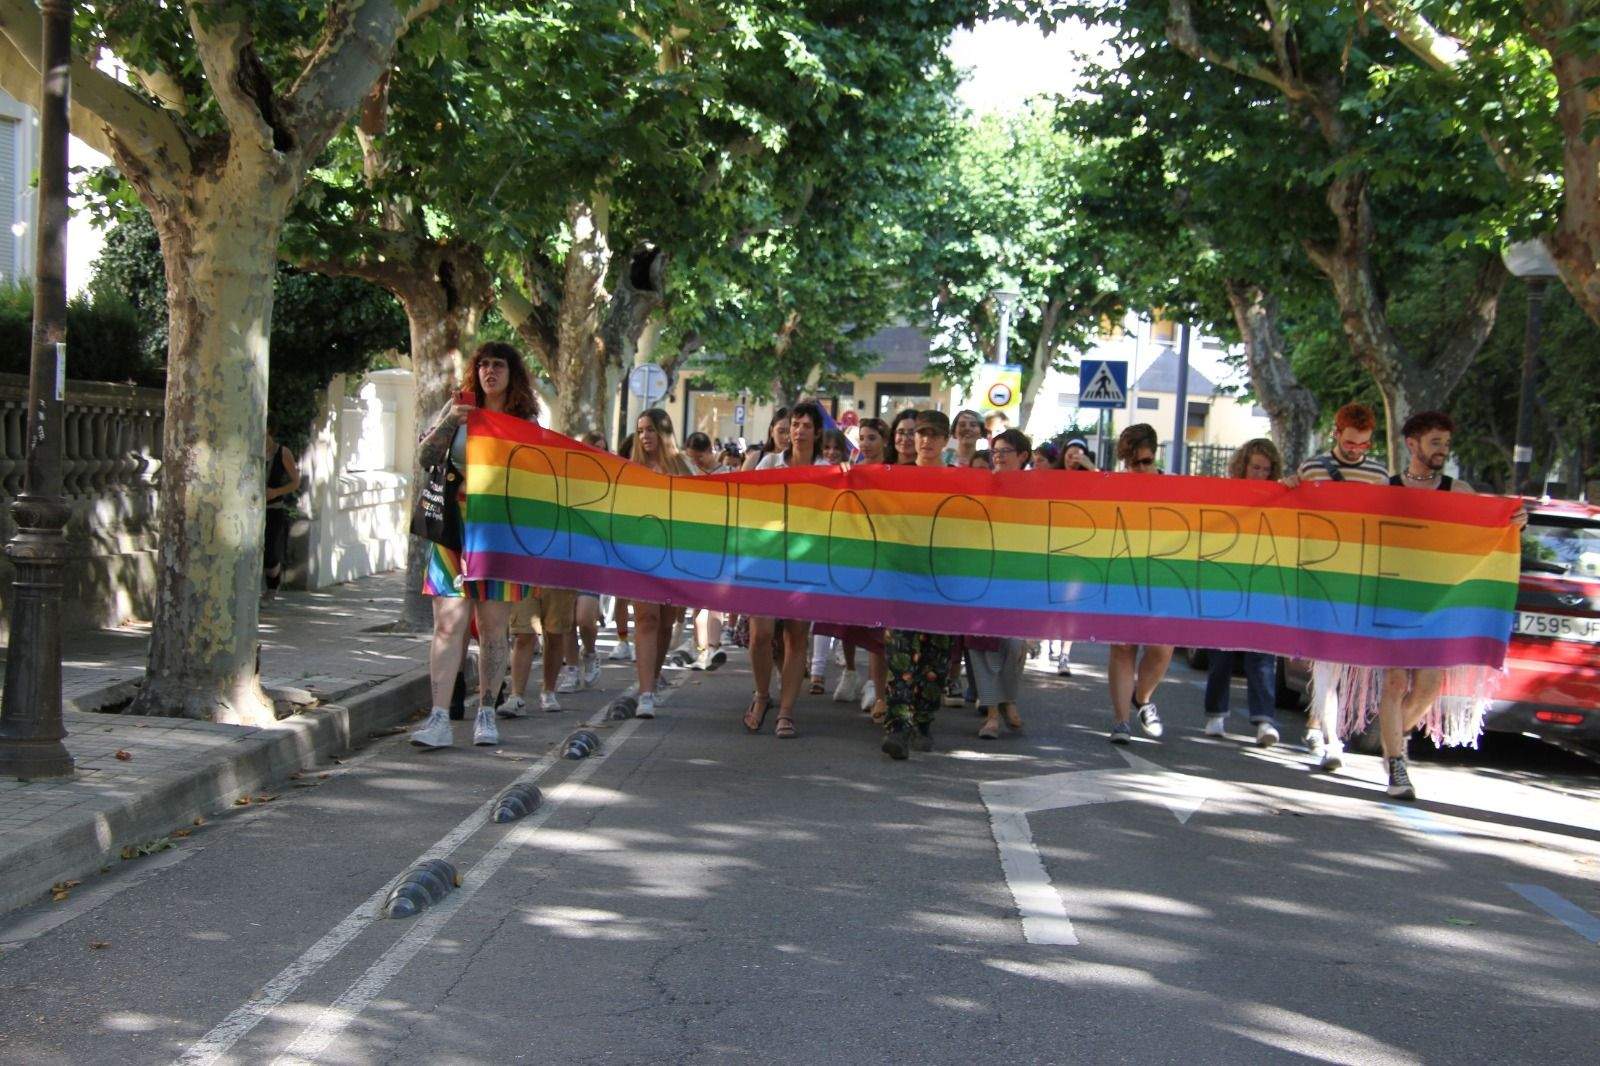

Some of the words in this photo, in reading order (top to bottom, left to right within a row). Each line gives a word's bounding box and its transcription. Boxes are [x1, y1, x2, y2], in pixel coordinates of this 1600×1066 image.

[506, 444, 877, 594] ORGULLO
[929, 494, 995, 602] O
[1047, 500, 1429, 629] BARBARIE
[1524, 615, 1572, 634] 7595
